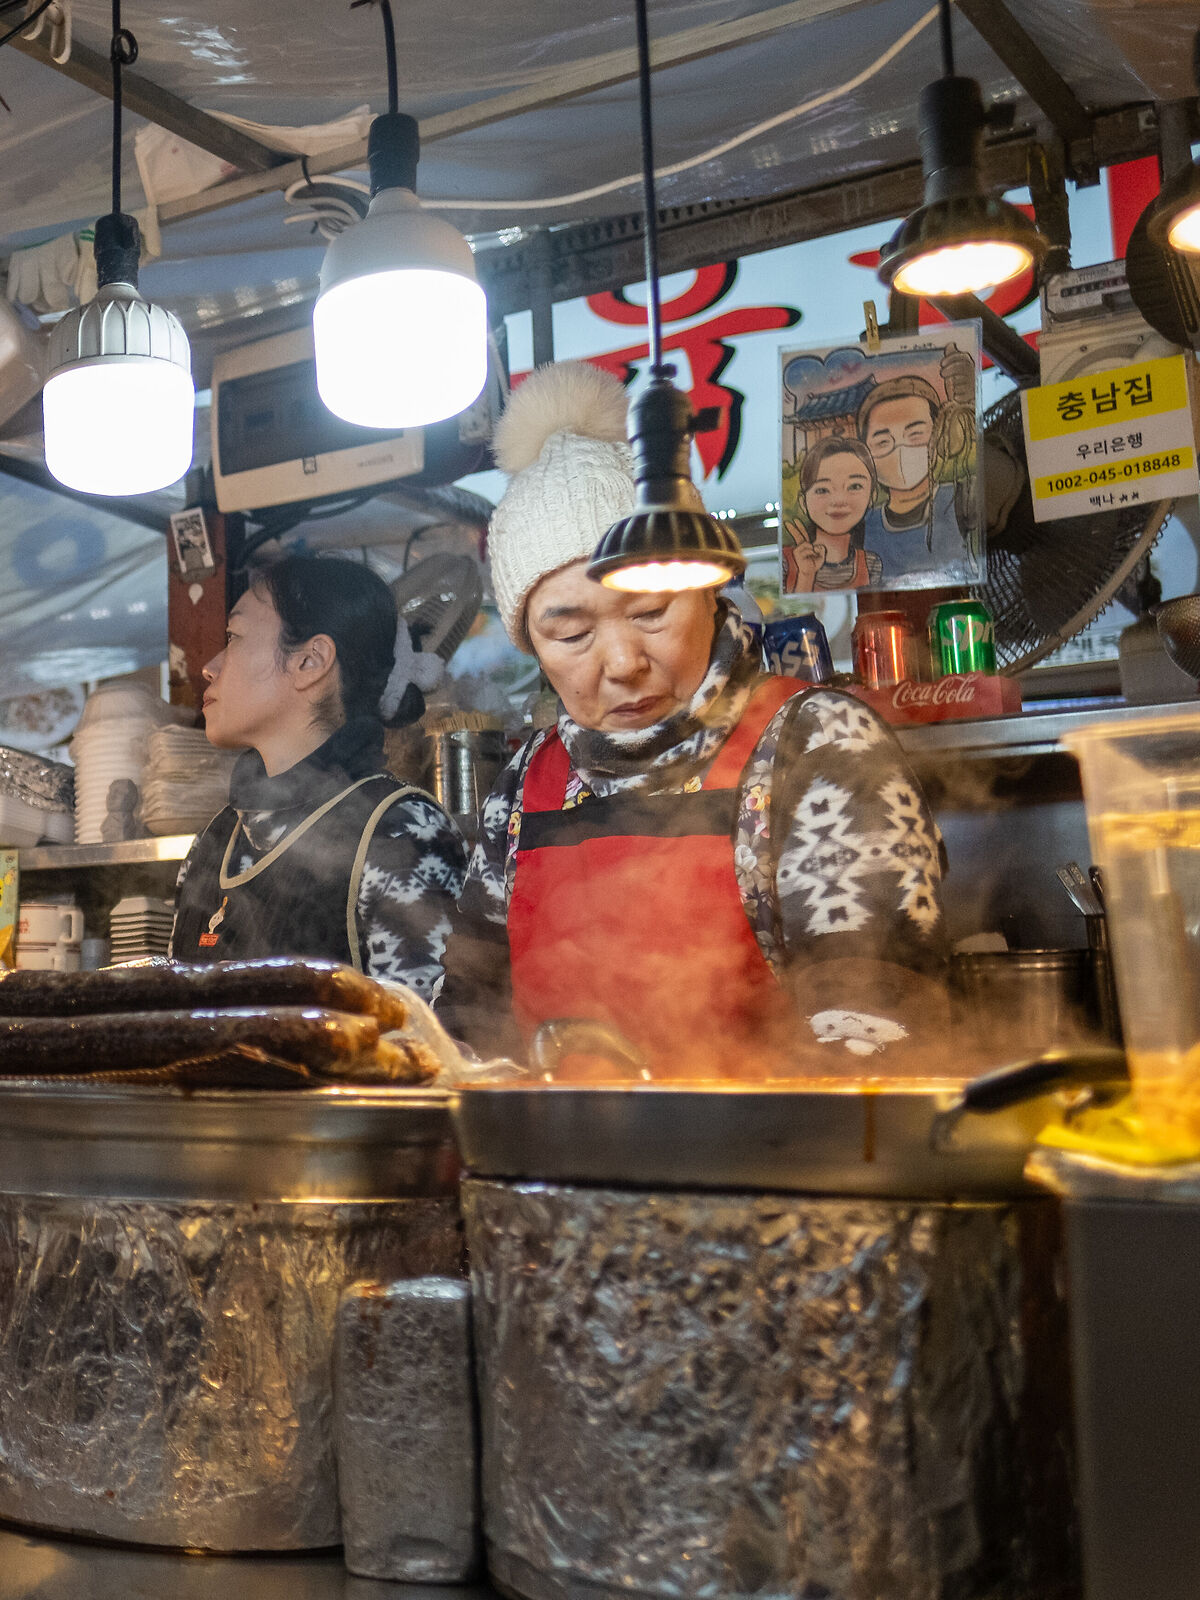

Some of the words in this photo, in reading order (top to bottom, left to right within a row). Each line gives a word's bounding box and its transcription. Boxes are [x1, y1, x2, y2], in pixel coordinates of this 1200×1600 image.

[1056, 373, 1153, 422] 충남집
[1076, 432, 1143, 460] 우리은행
[1047, 454, 1181, 493] 1002-045-018848
